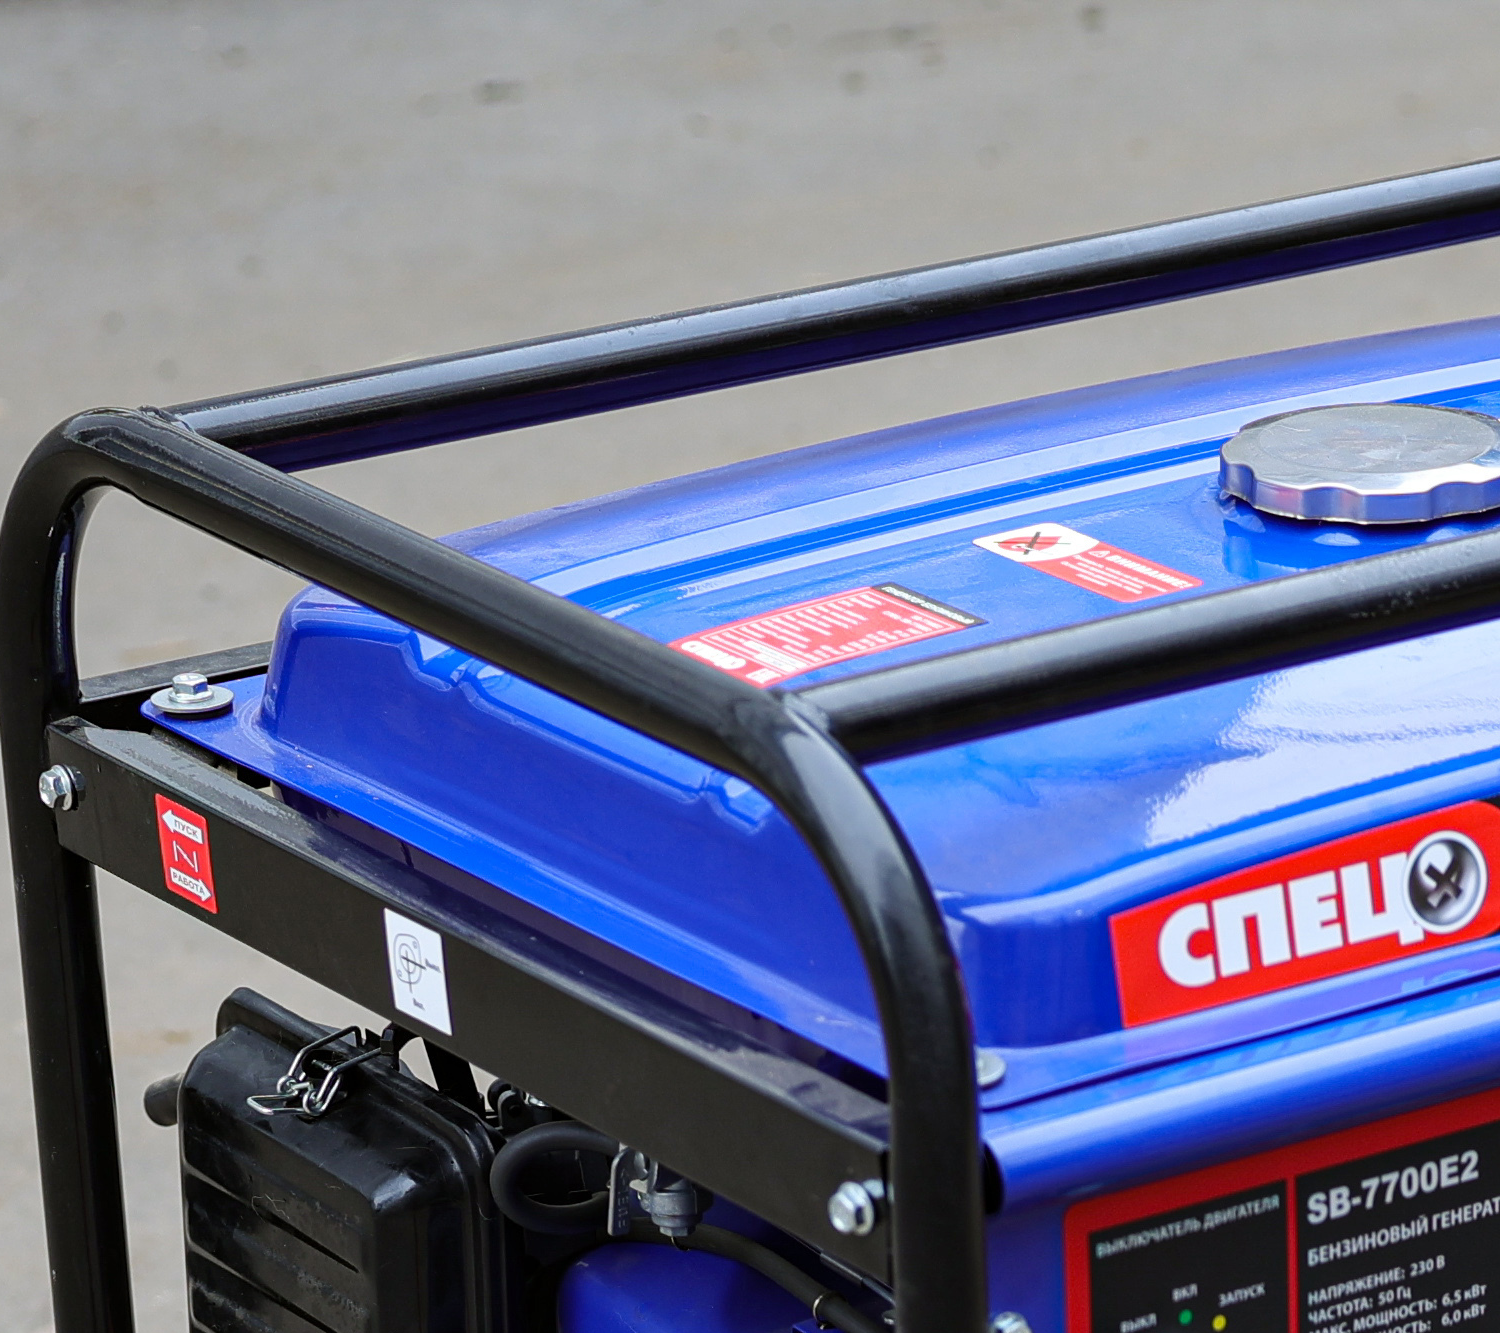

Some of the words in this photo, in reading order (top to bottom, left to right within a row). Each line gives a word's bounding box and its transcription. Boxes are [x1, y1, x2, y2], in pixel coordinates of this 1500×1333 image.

[174, 819, 198, 839] ПУСК
[173, 871, 205, 895] РАБОТА
[1307, 1150, 1479, 1225] SB-7700E2
[1096, 1217, 1201, 1259] ВЫКЛЮЧАТЕЛЬ
[1203, 1194, 1280, 1232] ДВИГАТЕЛЯ
[1307, 1214, 1428, 1268] БЕНЗИНОВЫЙ
[1172, 1283, 1197, 1302] ВКЛ
[1218, 1282, 1265, 1308] ЗАПУСК
[1308, 1266, 1405, 1306] НАПРЯЖЕНИЕ:
[1410, 1258, 1434, 1277] 230
[1436, 1254, 1446, 1270] В
[1308, 1296, 1373, 1324] ЧАСТОТА:
[1378, 1290, 1394, 1306] 50
[1397, 1286, 1412, 1300] Гц
[1353, 1298, 1437, 1332] МОЩНОСТЬ:
[1441, 1289, 1461, 1307] 6,5
[1464, 1283, 1487, 1301] кВт
[1441, 1309, 1461, 1327] 6,0
[1463, 1303, 1487, 1320] кВт
